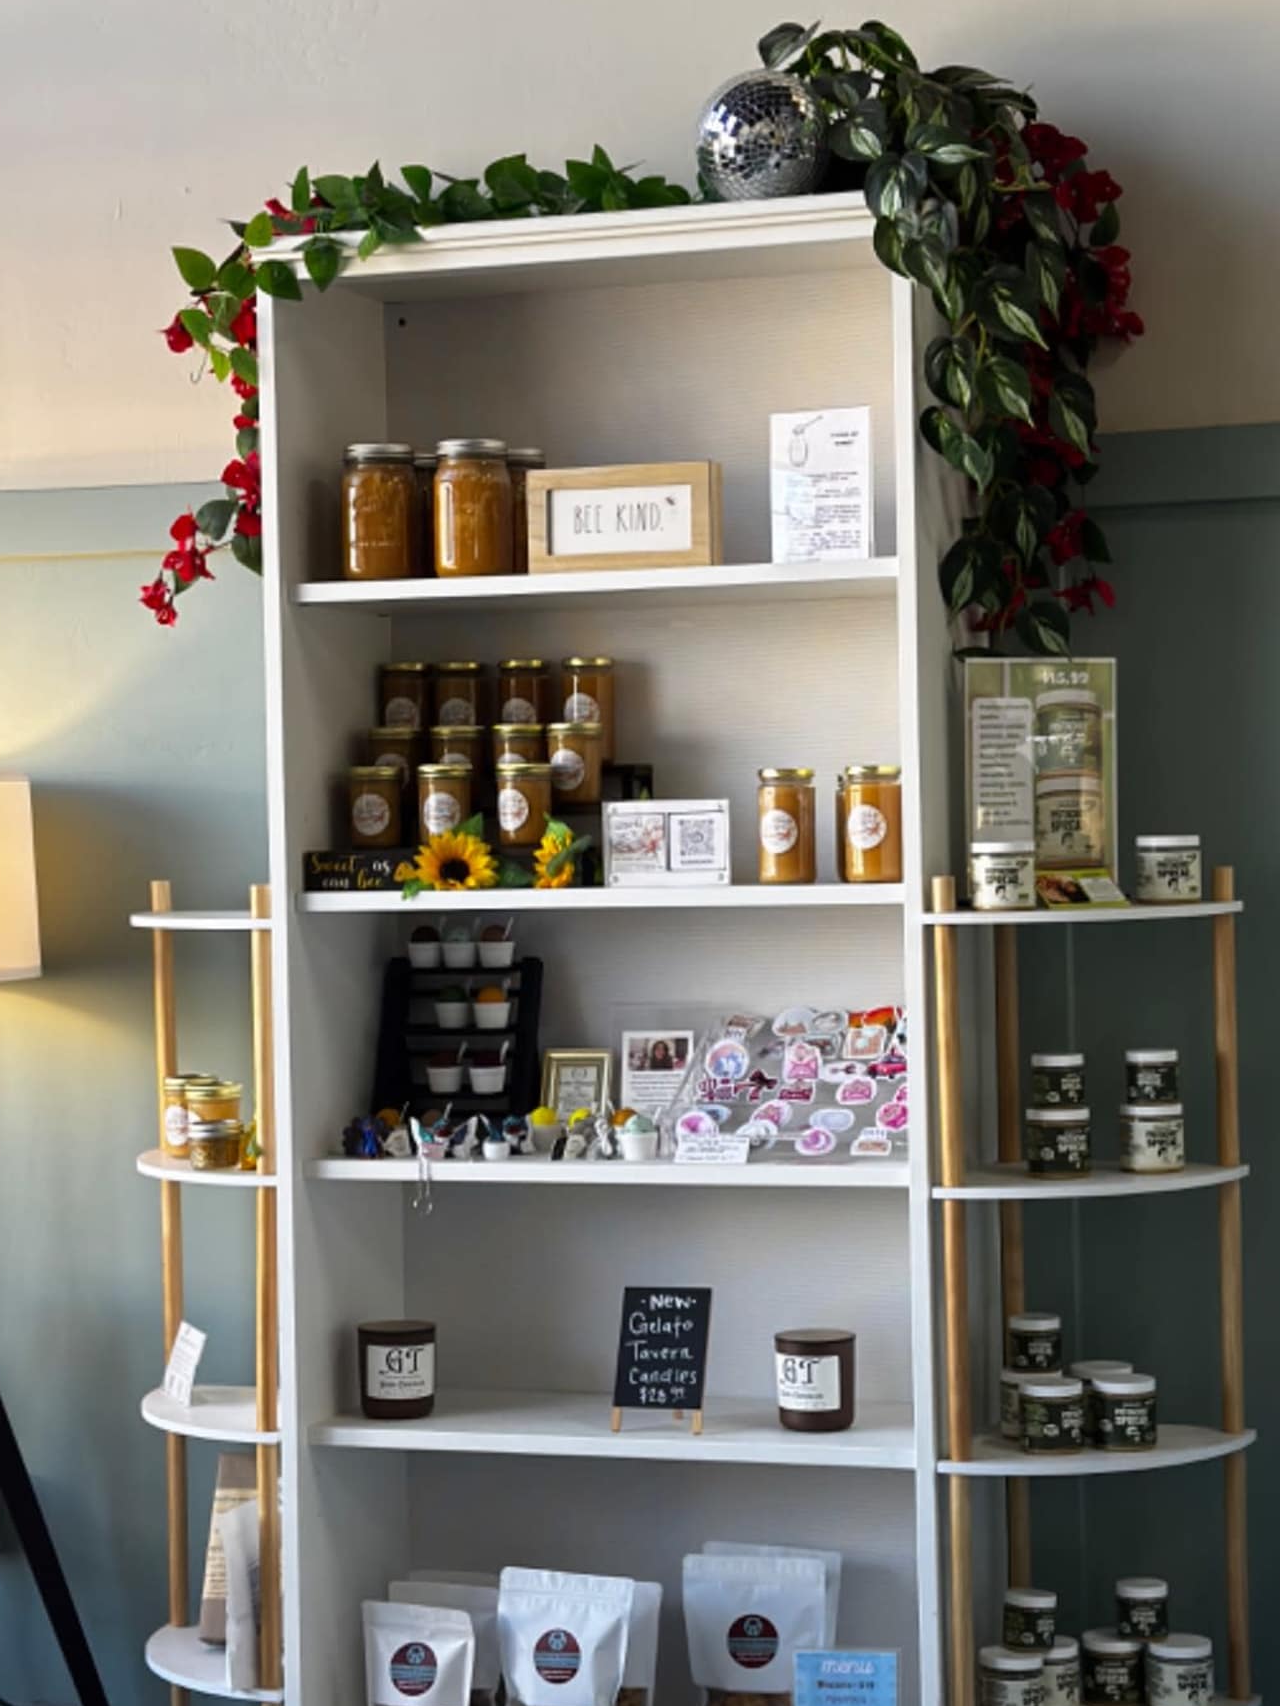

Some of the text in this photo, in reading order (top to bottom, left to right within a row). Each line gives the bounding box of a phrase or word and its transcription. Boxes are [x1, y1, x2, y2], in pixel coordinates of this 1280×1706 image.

[573, 505, 604, 535] BEE
[629, 1312, 694, 1338] Gelato
[626, 1340, 694, 1361] Tavern
[629, 1367, 698, 1385] Candles
